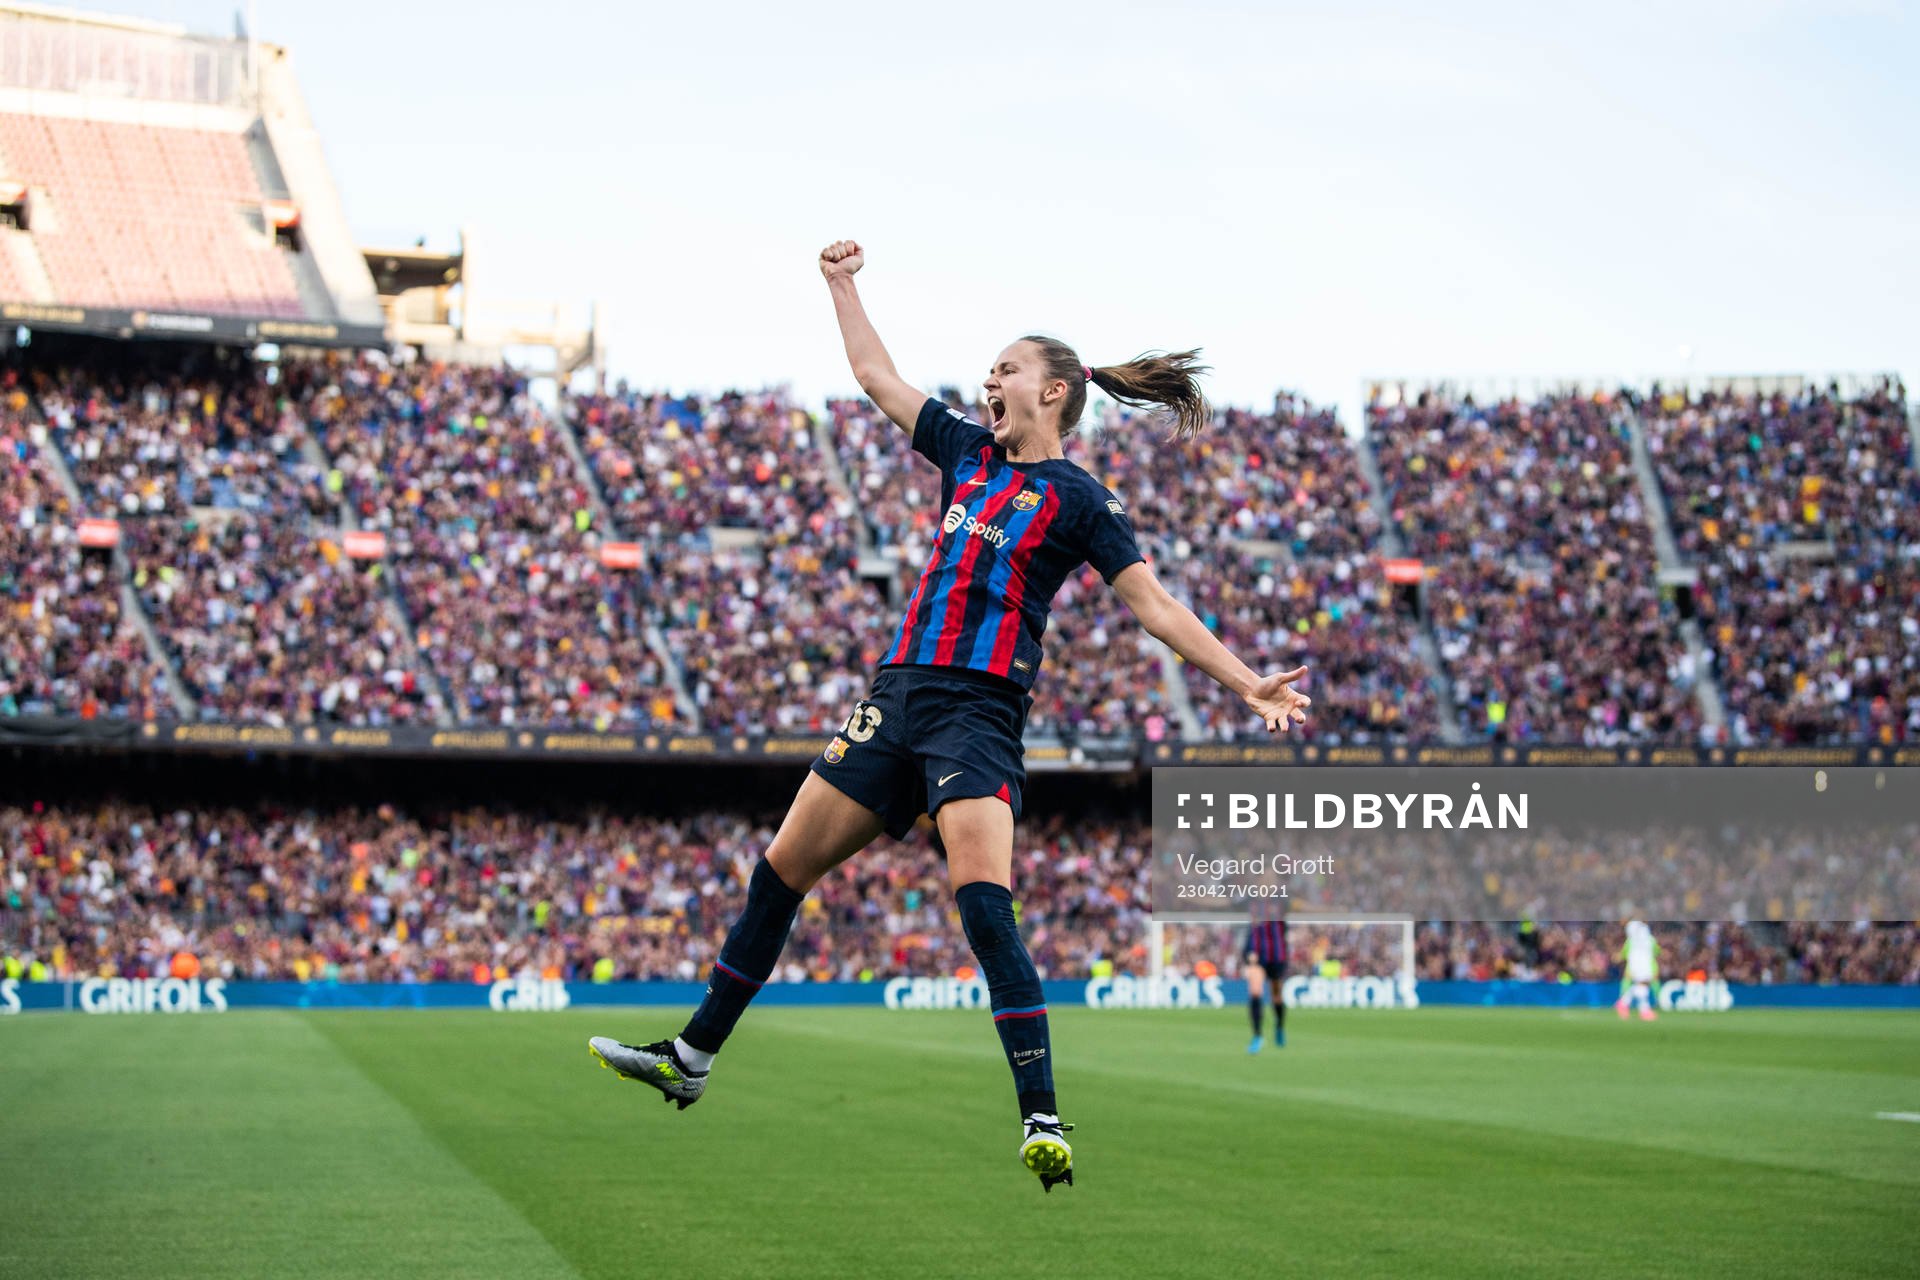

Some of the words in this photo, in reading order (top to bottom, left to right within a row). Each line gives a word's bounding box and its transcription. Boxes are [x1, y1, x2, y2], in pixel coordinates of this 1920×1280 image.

[963, 516, 1010, 548] Spotify
[839, 701, 882, 743] 6
[79, 977, 228, 1014] GRIFOLS
[884, 976, 991, 1010] GRIFO
[1085, 975, 1226, 1009] GRIFOLS
